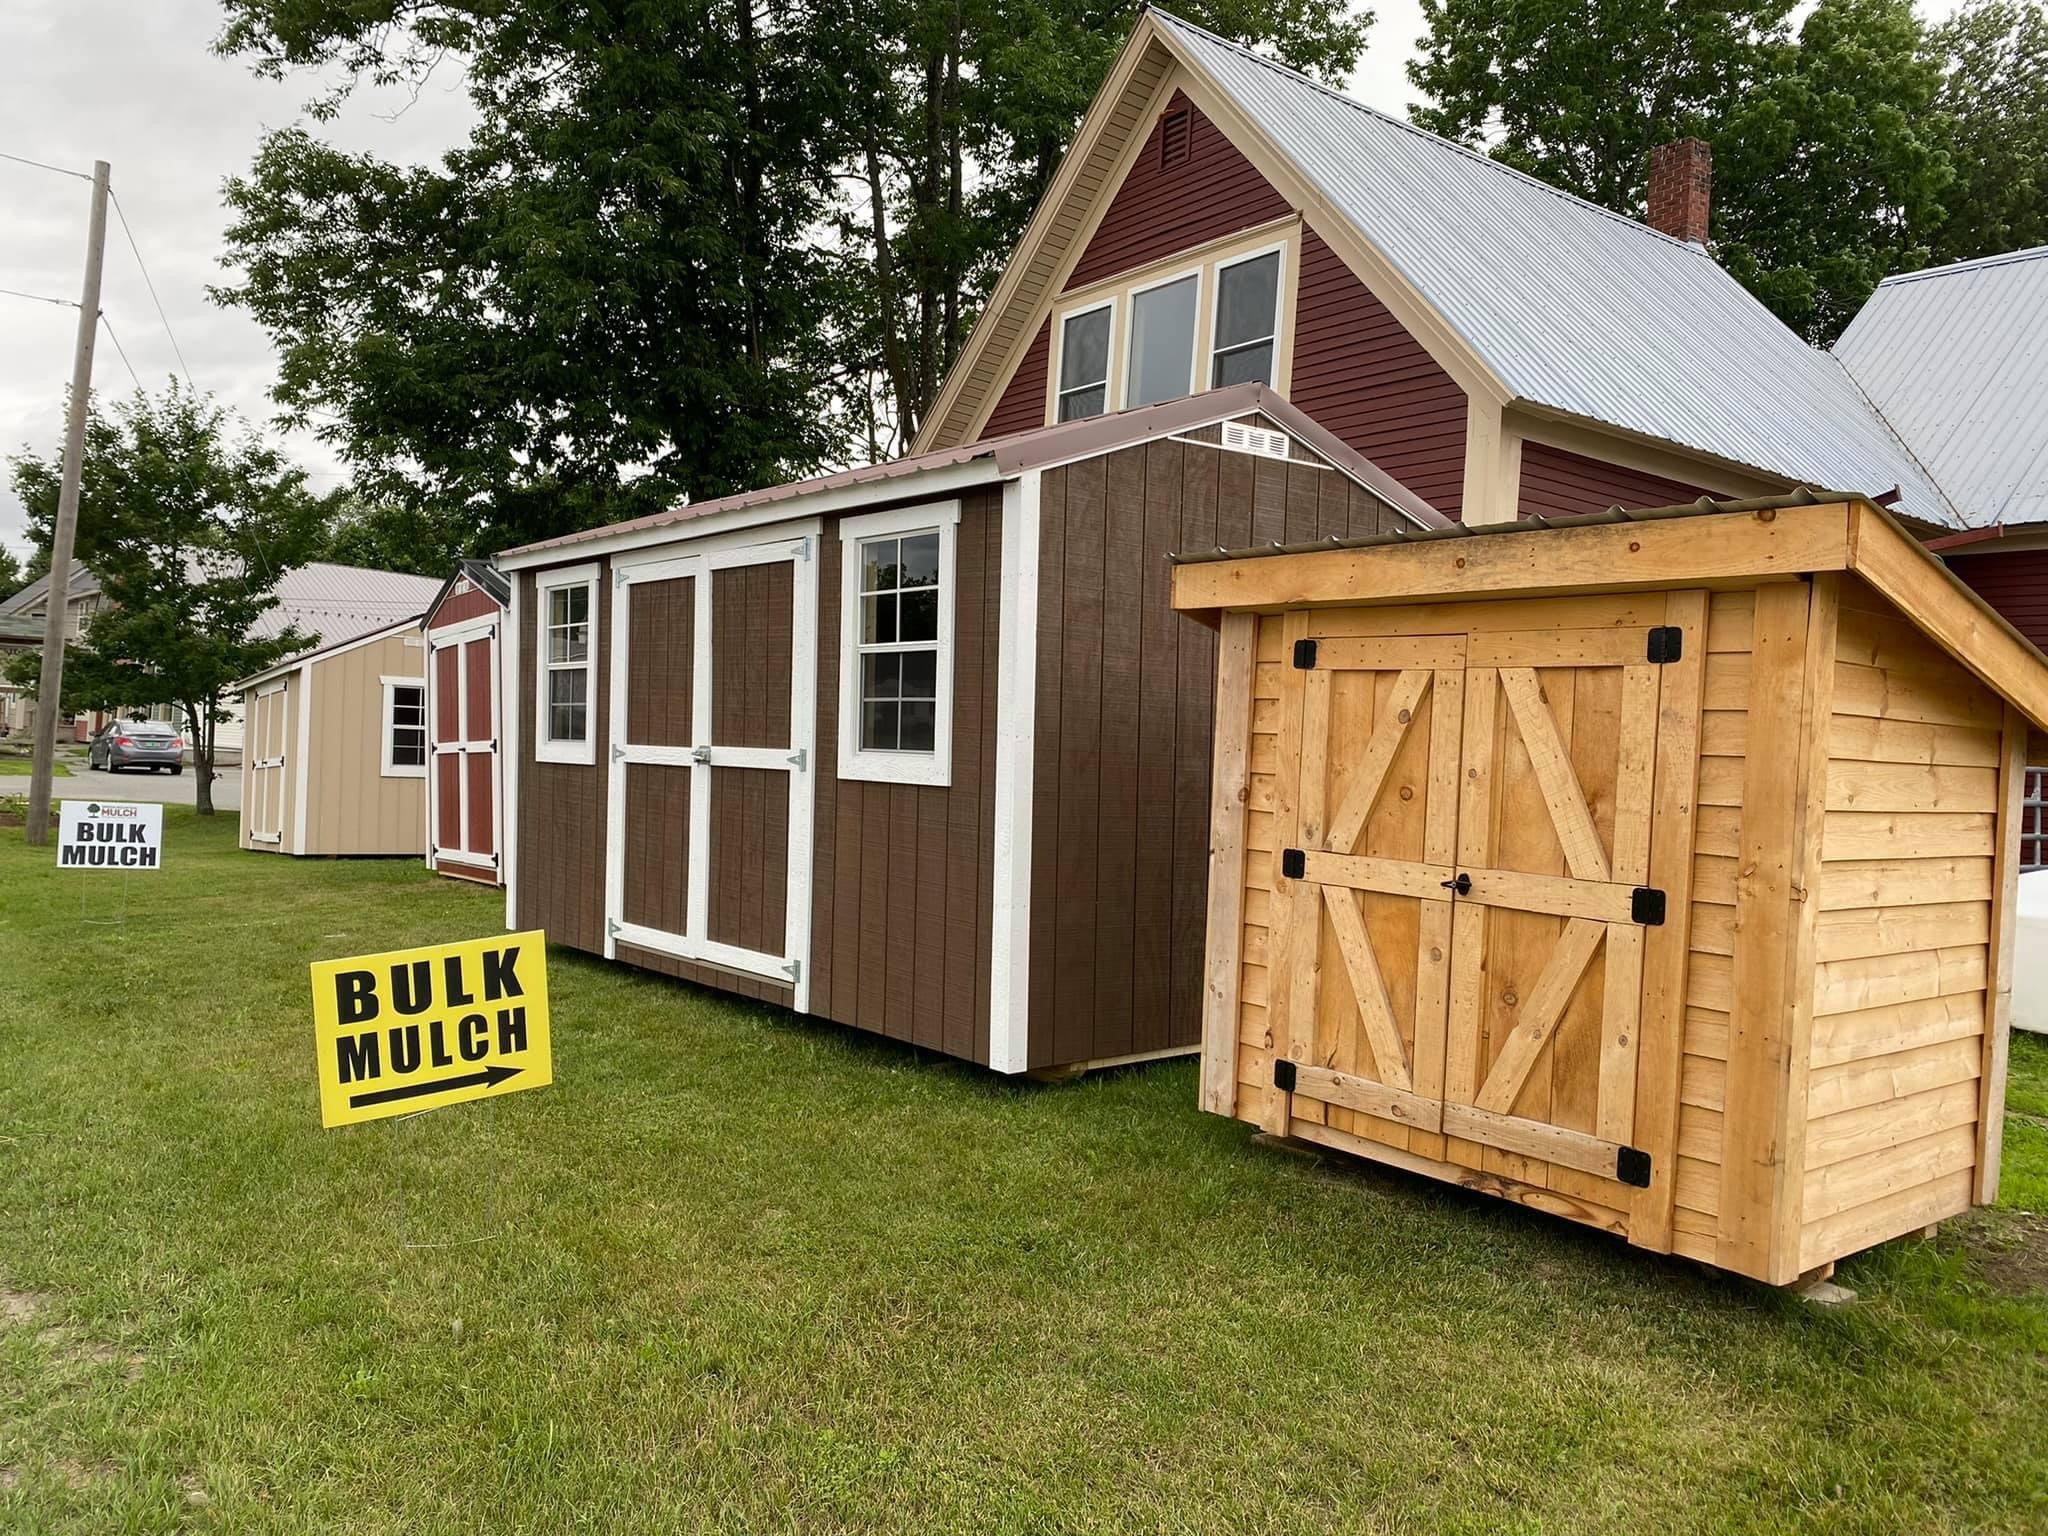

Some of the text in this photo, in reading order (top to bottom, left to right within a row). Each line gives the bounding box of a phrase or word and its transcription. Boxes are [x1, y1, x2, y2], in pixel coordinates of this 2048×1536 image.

[102, 807, 137, 816] MULCH
[76, 822, 146, 843] BULK
[62, 845, 156, 867] MULCH
[334, 946, 524, 1025] BULK
[336, 1006, 528, 1084] MULCH
